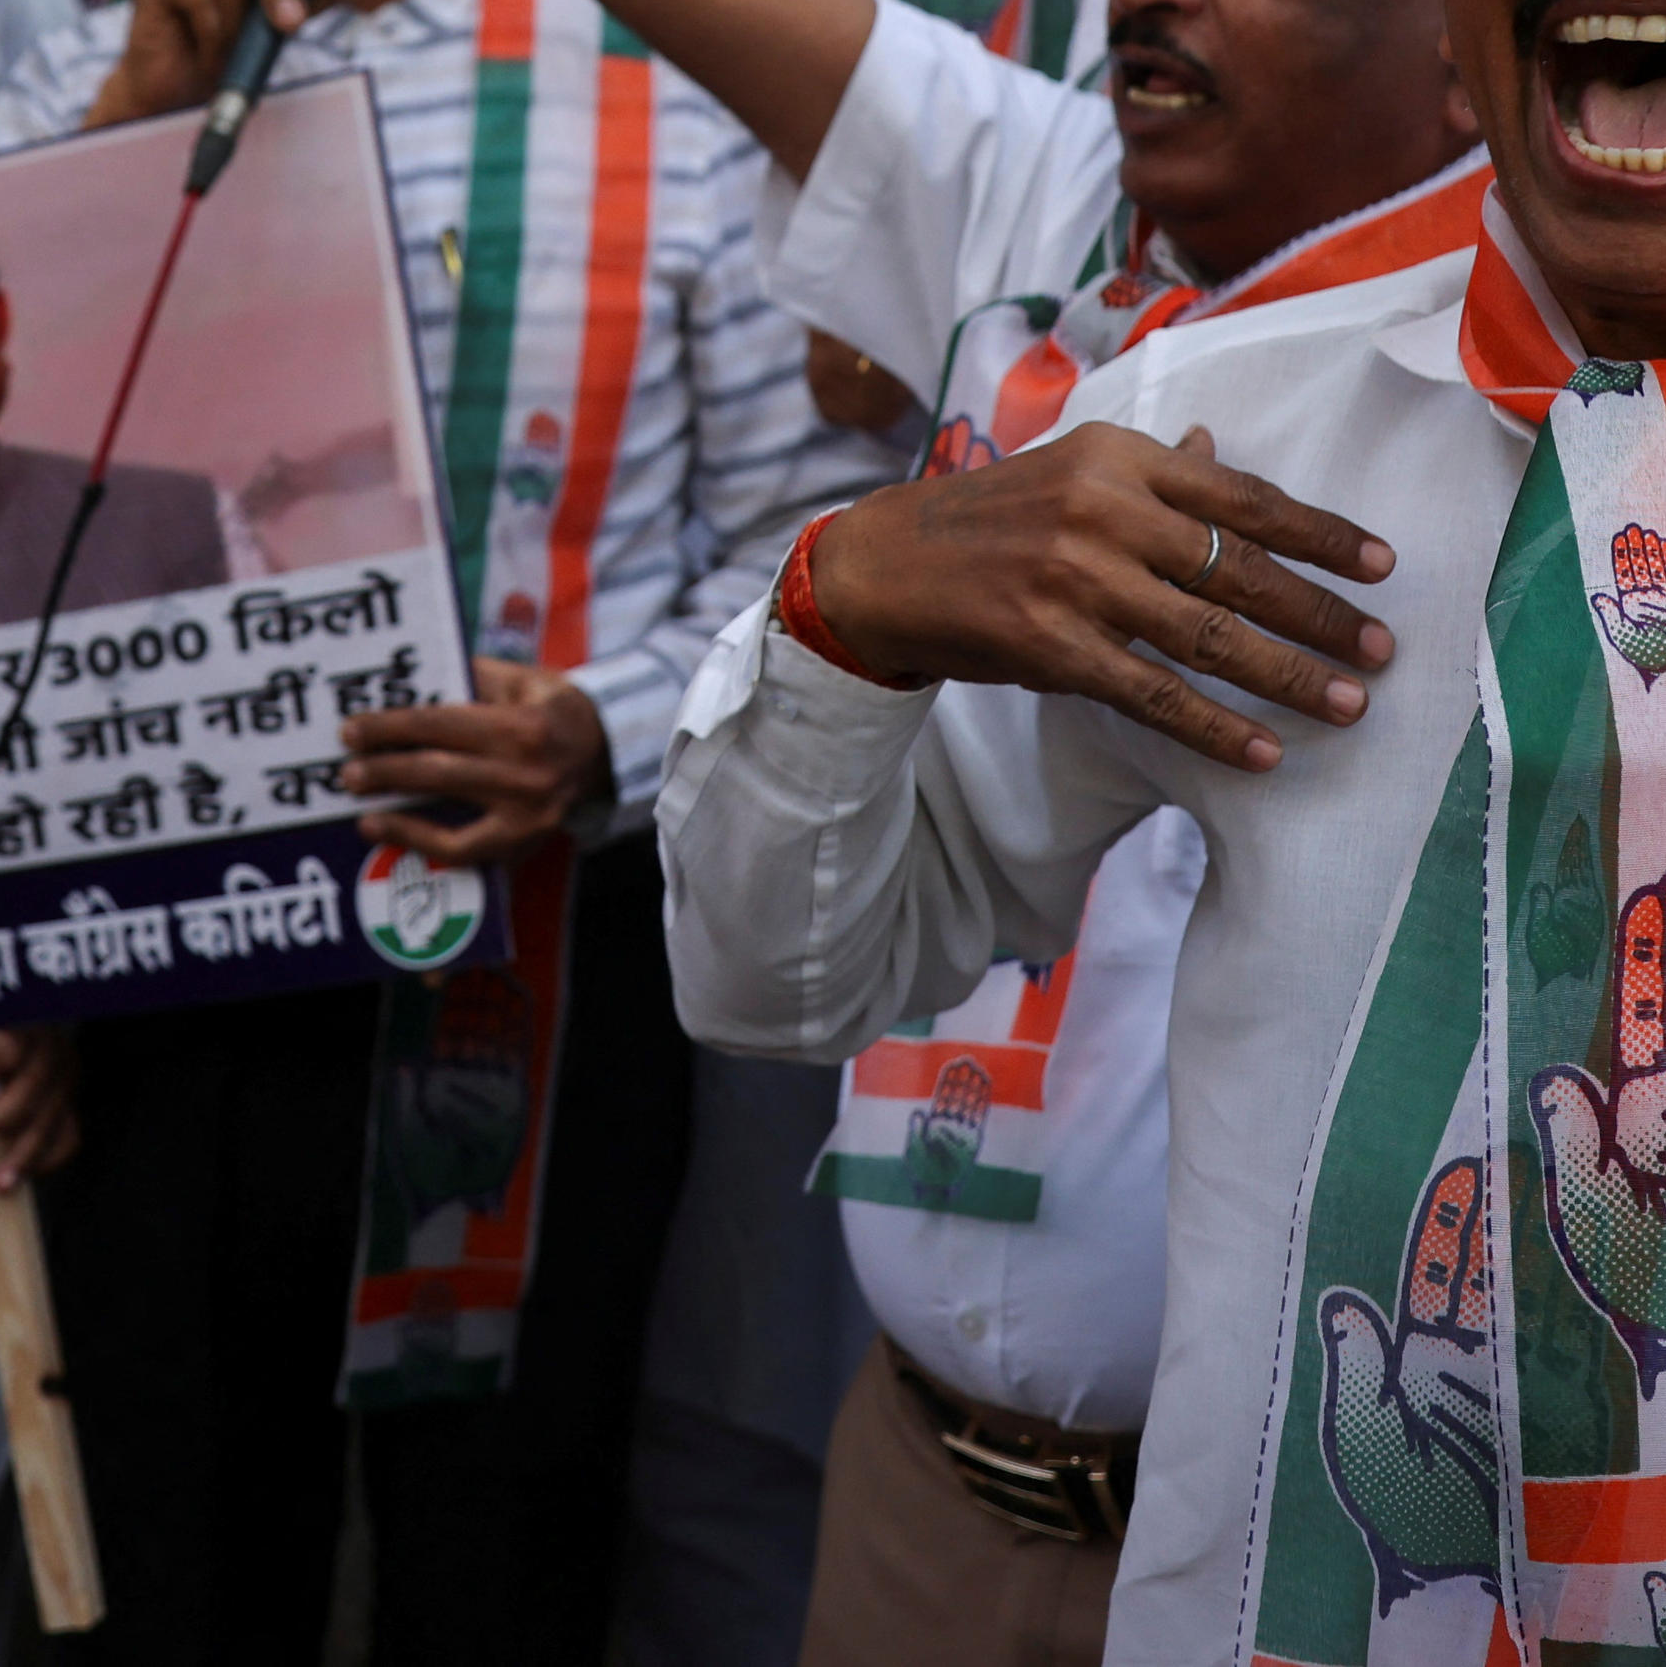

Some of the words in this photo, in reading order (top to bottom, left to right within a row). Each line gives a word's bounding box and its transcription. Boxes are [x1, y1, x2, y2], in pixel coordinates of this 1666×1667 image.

[44, 619, 211, 688] 3000
[225, 570, 404, 653] किलो
[54, 697, 186, 763] जांच
[197, 665, 321, 739] नहीं
[59, 772, 163, 843] रही
[178, 757, 247, 829] है,
[172, 854, 345, 963] कमिटी
